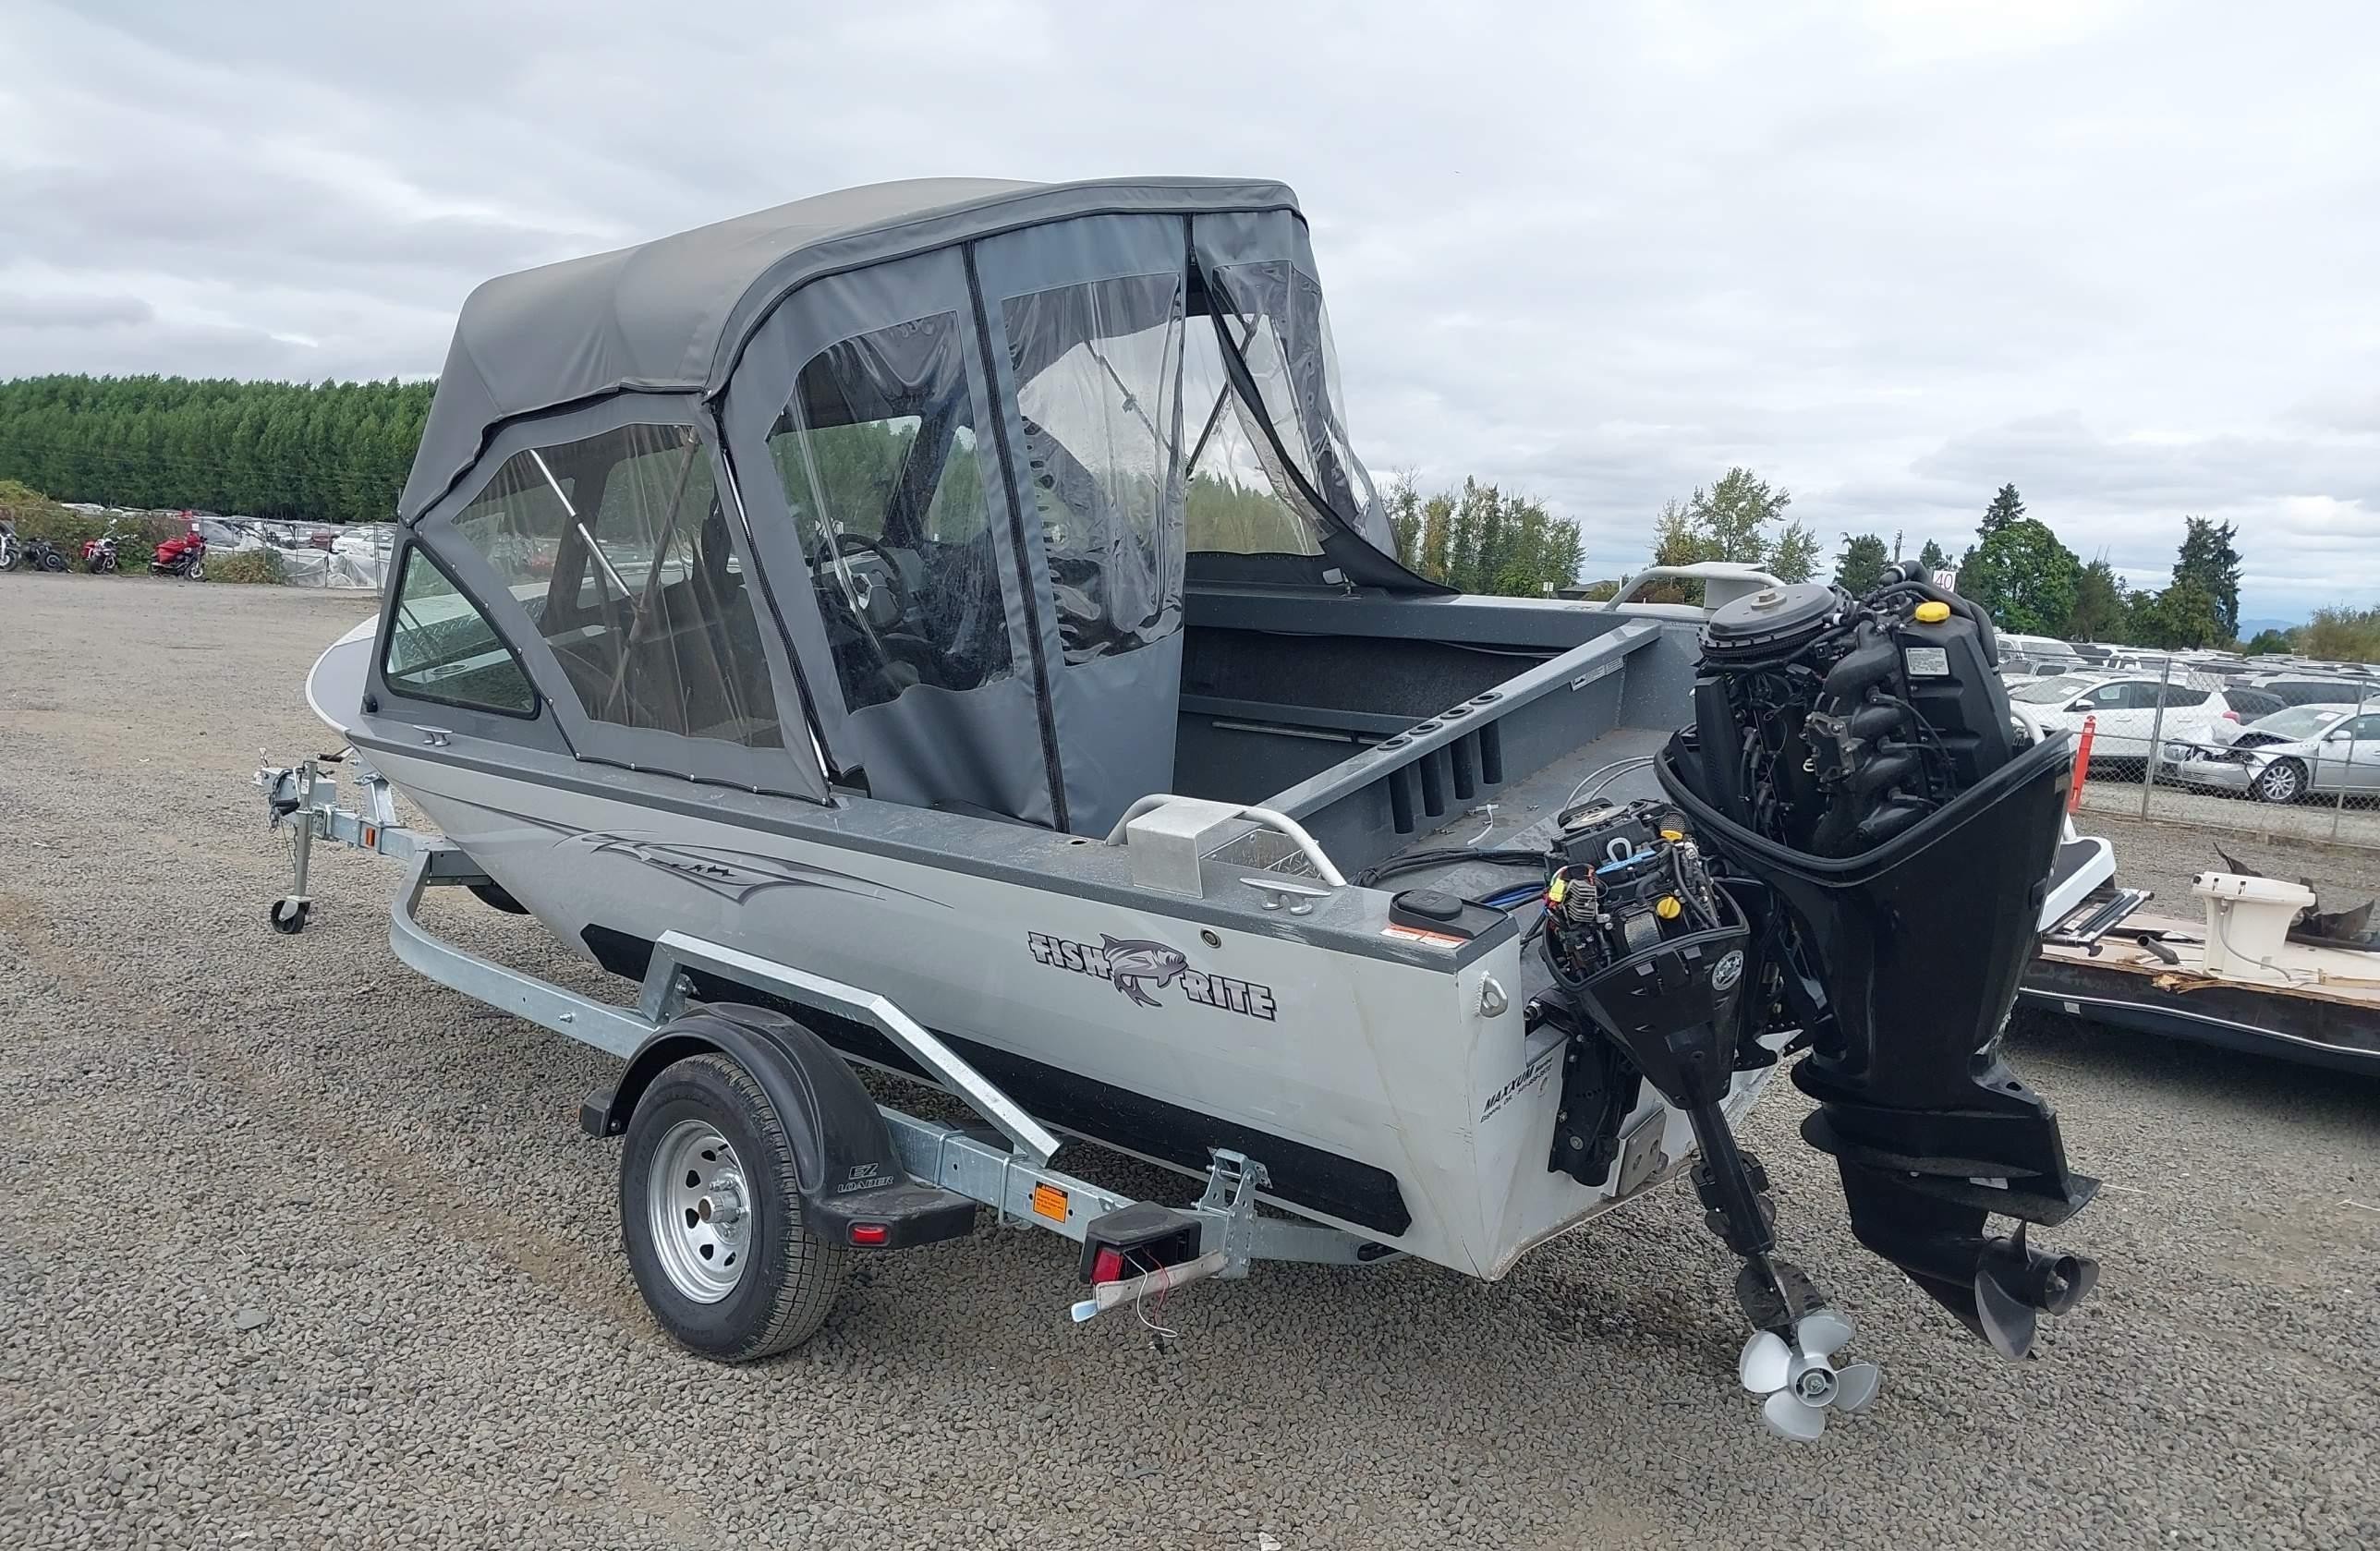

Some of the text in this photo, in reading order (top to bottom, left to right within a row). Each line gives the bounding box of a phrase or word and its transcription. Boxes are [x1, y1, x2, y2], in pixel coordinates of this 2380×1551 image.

[1936, 573, 1952, 590] 40
[1027, 931, 1277, 1022] FISH RITE
[1484, 1064, 1536, 1112] MAXXUM
[849, 1163, 879, 1180] EZ
[837, 1176, 894, 1193] LOADER
